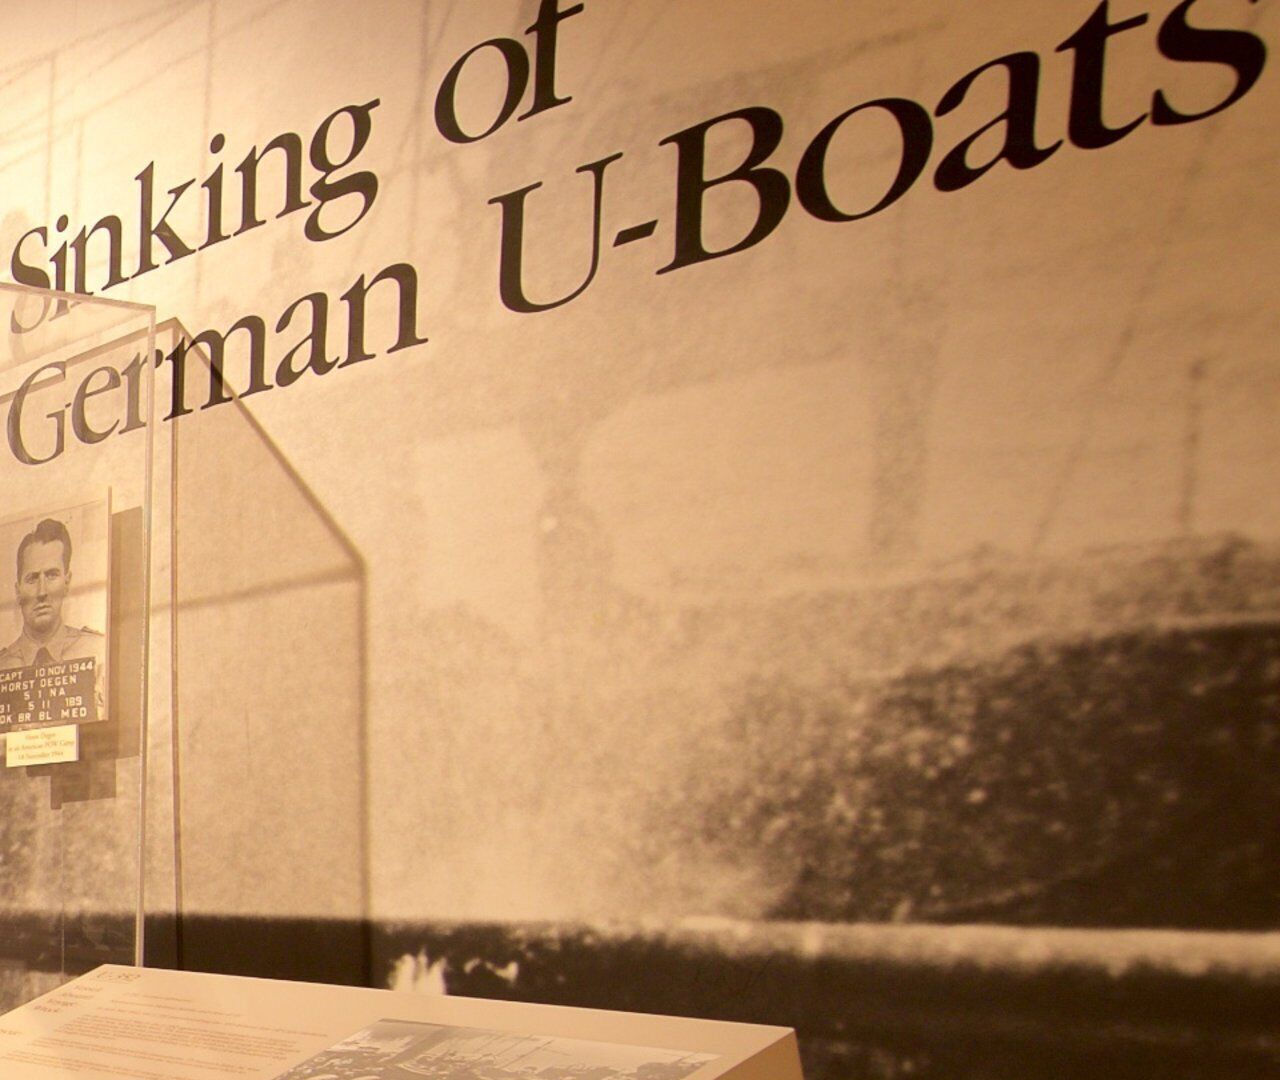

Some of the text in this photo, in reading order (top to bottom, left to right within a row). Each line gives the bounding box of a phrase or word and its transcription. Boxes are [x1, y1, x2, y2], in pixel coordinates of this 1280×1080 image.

[8, 0, 587, 336] Sinking of
[6, 0, 1269, 468] German U-Boats
[0, 660, 93, 682] CAPT 10 NOV 1944
[1, 675, 77, 693] HORST DEGEN
[39, 711, 53, 721] BL
[61, 707, 88, 719] MED
